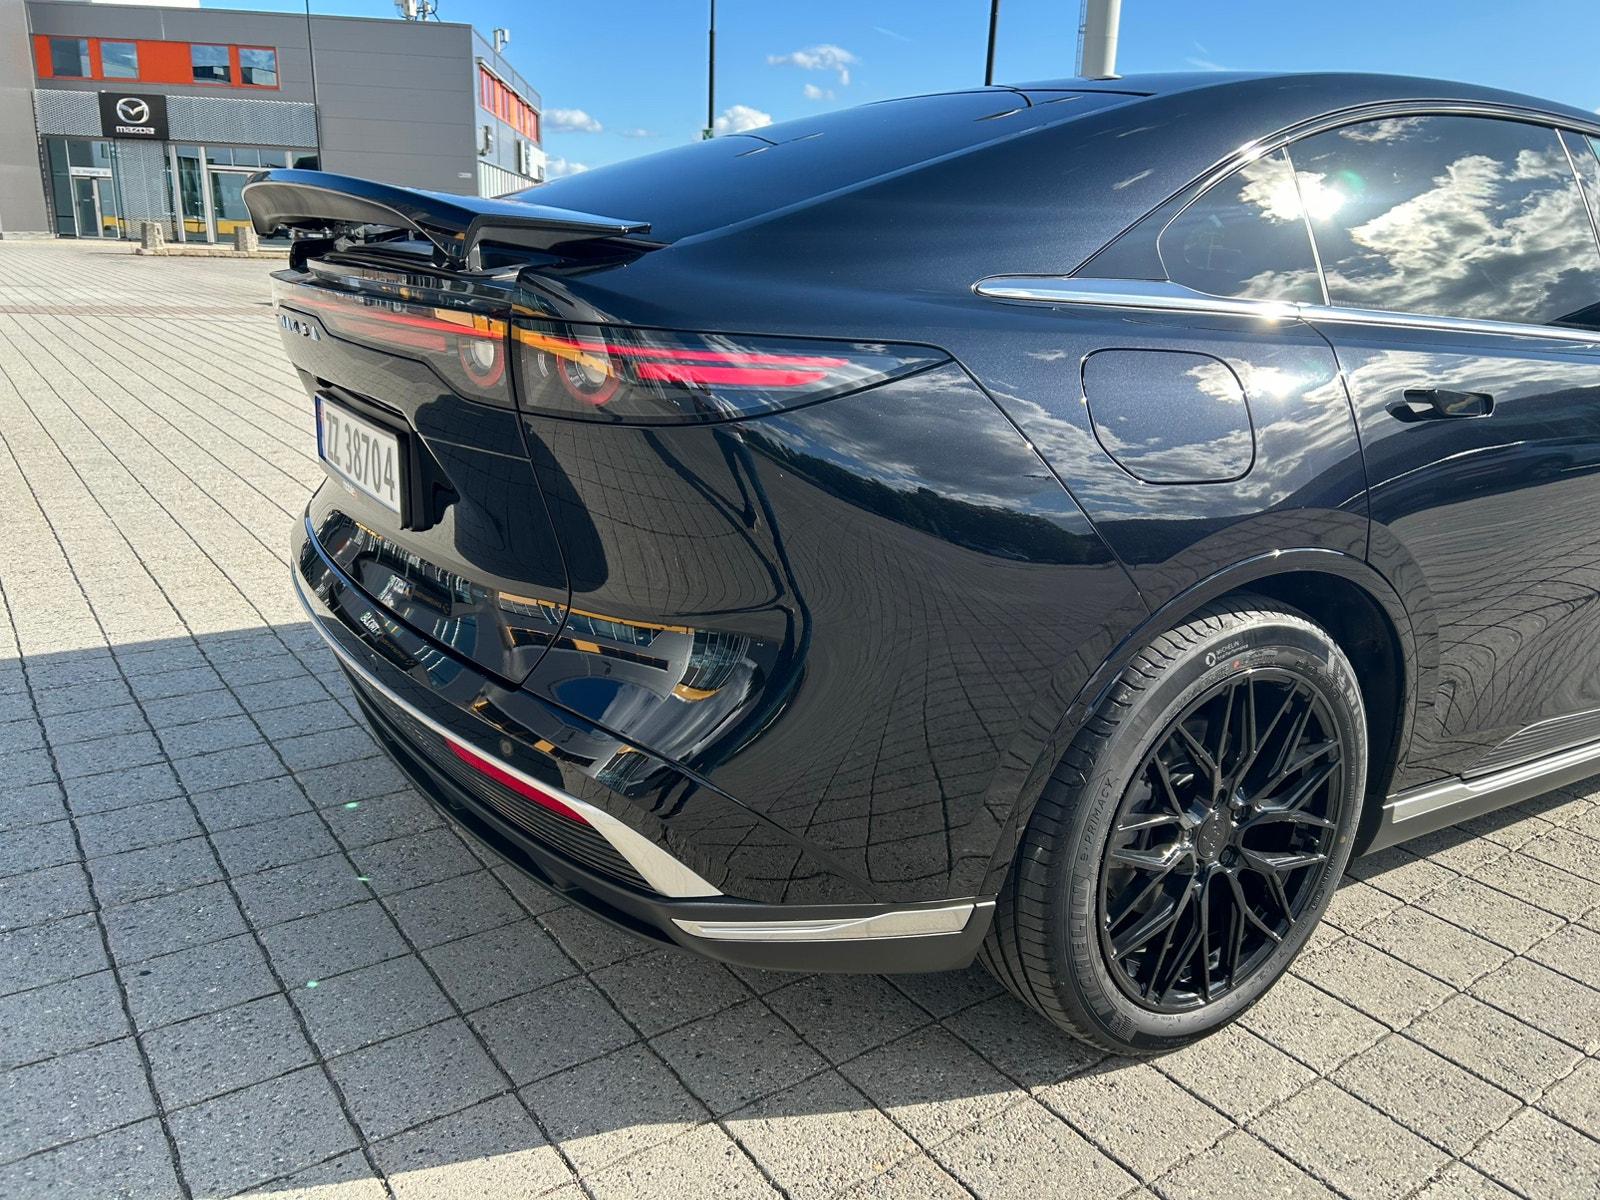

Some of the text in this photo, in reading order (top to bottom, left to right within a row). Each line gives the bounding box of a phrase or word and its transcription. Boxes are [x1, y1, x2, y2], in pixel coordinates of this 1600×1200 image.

[115, 126, 155, 135] mazda
[326, 411, 395, 502] ZZ 38704
[1216, 640, 1240, 655] MICHELIN
[1070, 885, 1113, 1016] MICHELIN
